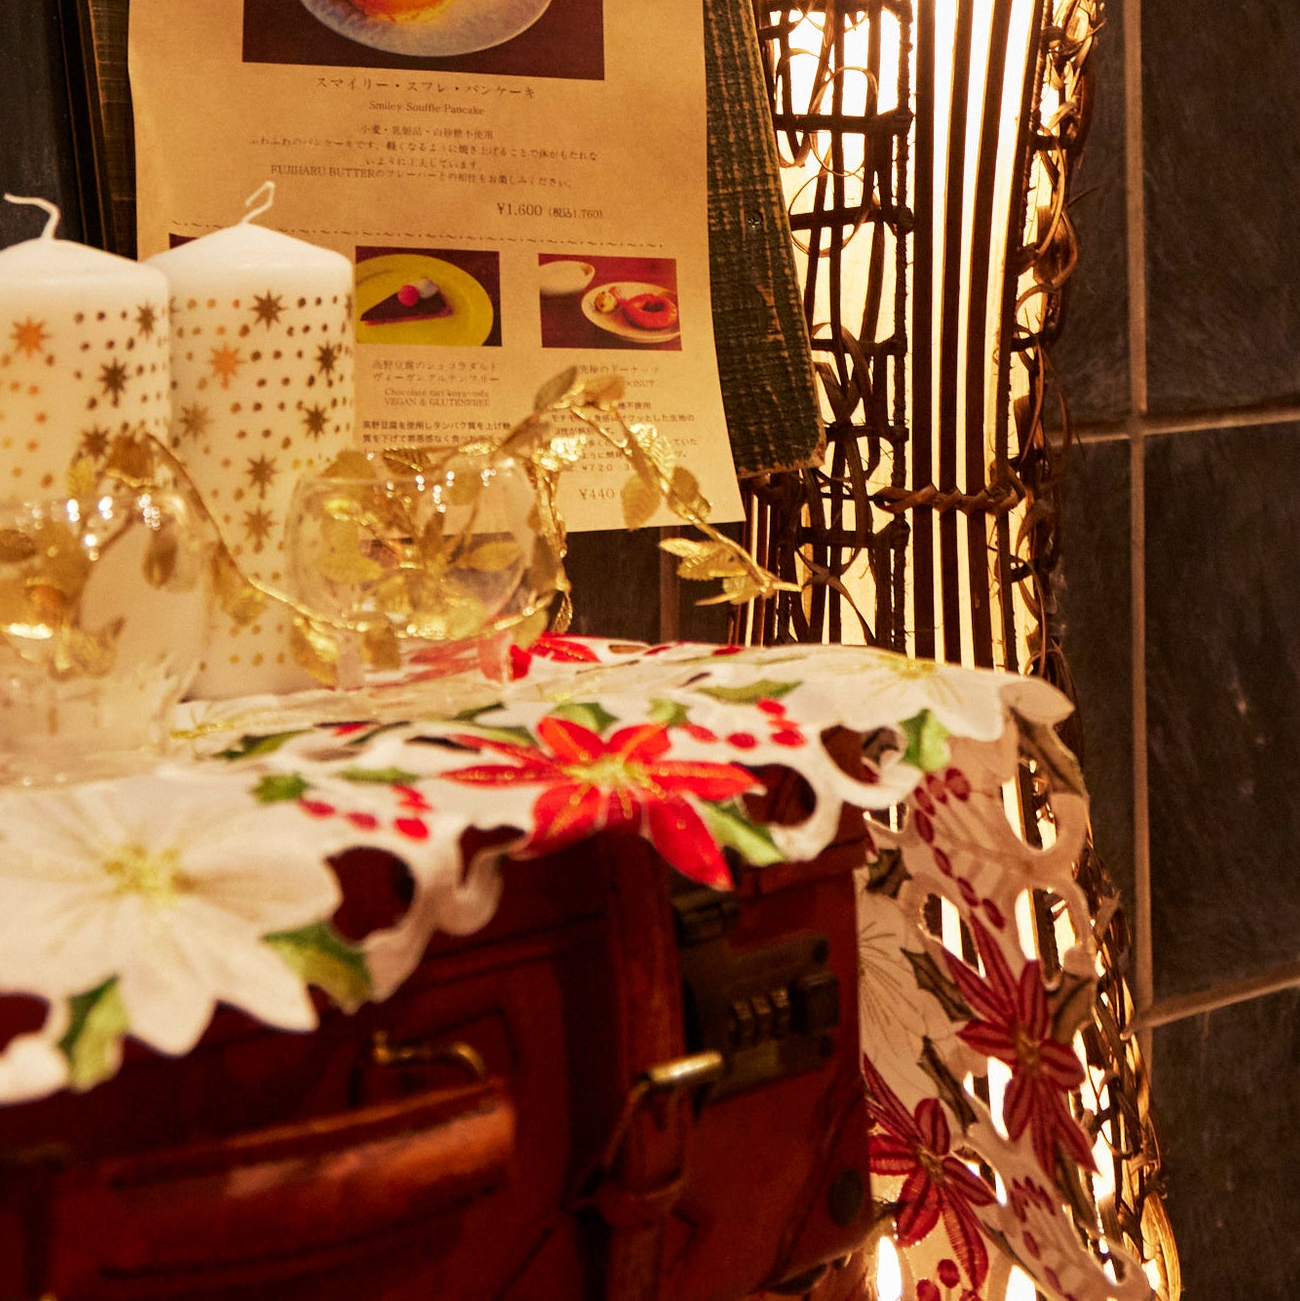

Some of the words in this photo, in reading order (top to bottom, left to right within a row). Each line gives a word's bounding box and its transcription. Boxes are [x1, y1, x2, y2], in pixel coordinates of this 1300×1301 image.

[369, 100, 402, 113] Smiley
[444, 105, 485, 116] Pancake
[270, 164, 327, 178] FUJIHARU
[496, 202, 543, 217] ¥1,600
[578, 487, 616, 501] ¥440
